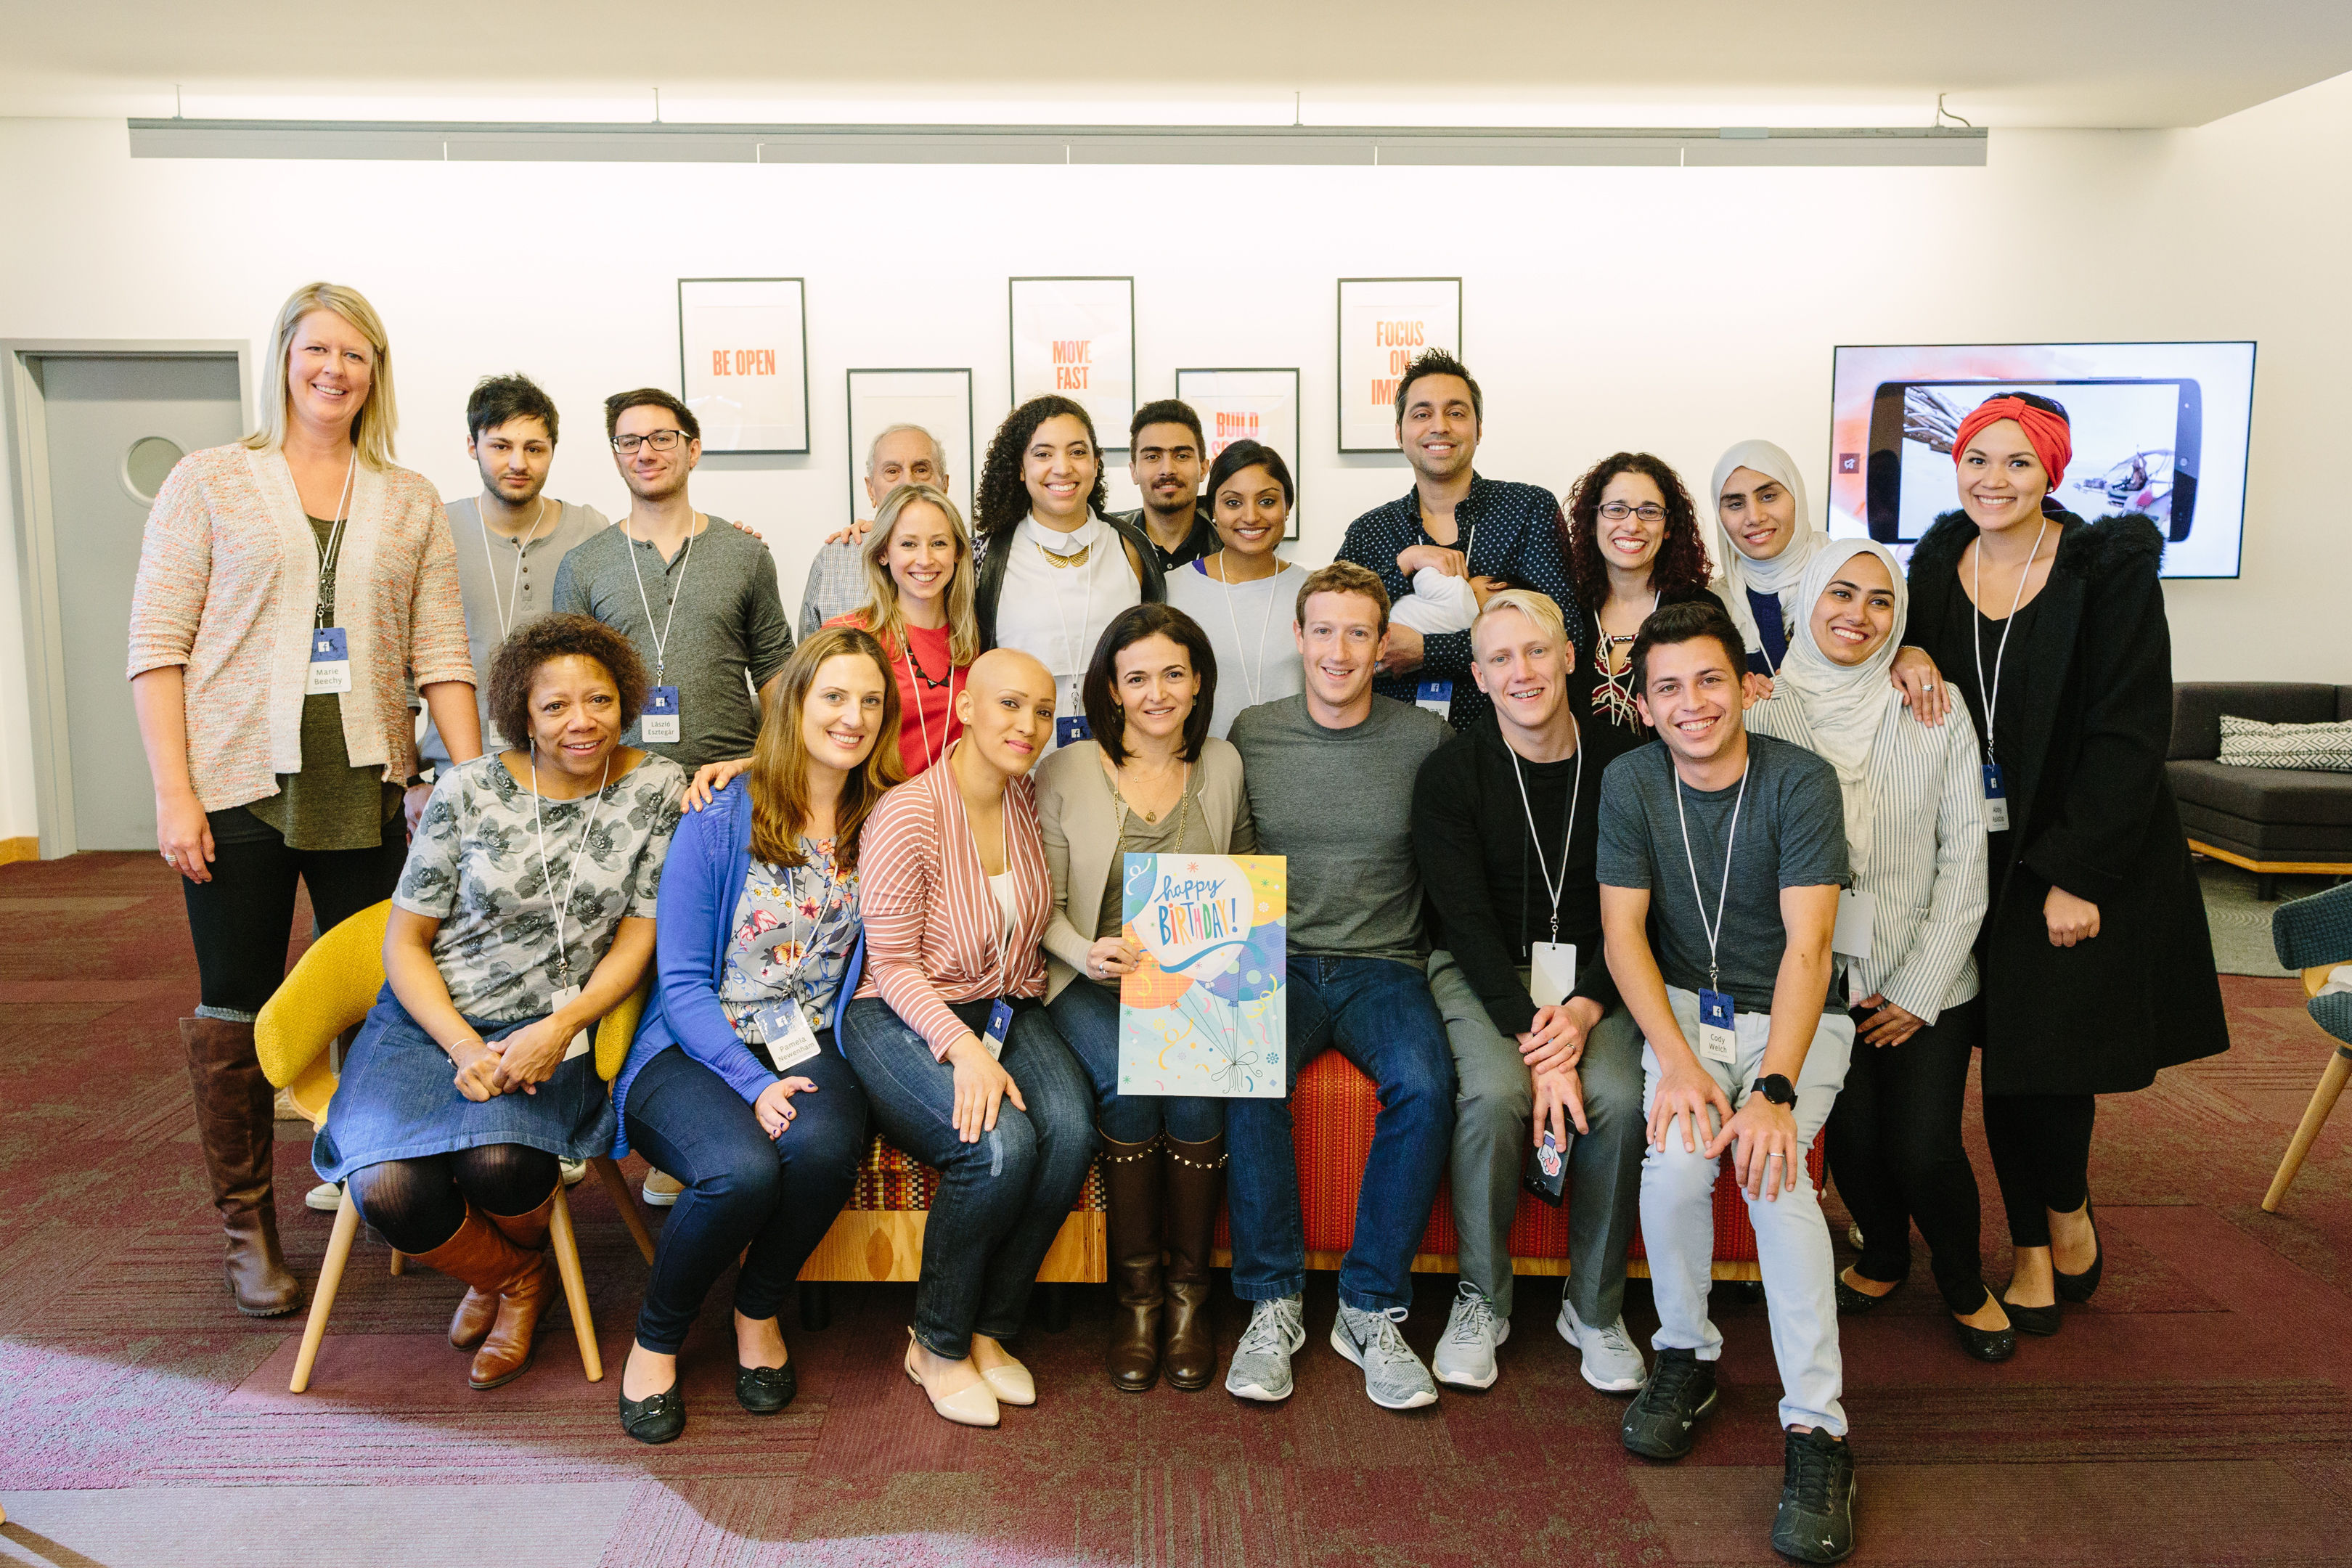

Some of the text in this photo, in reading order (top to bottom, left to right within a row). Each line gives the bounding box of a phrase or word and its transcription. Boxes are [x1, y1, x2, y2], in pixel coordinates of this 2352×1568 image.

[1376, 320, 1424, 347] FOCUS
[713, 349, 775, 375] BE OPEN
[1053, 340, 1093, 364] MOVE
[1389, 349, 1410, 376] ON
[1057, 367, 1090, 390] FAST
[1217, 412, 1259, 437] BUILD
[1154, 875, 1226, 903] happy
[777, 1041, 815, 1062] Newenham
[779, 1036, 807, 1053] Pamela
[1709, 1042, 1727, 1053] Welch
[1710, 1034, 1726, 1045] Cody
